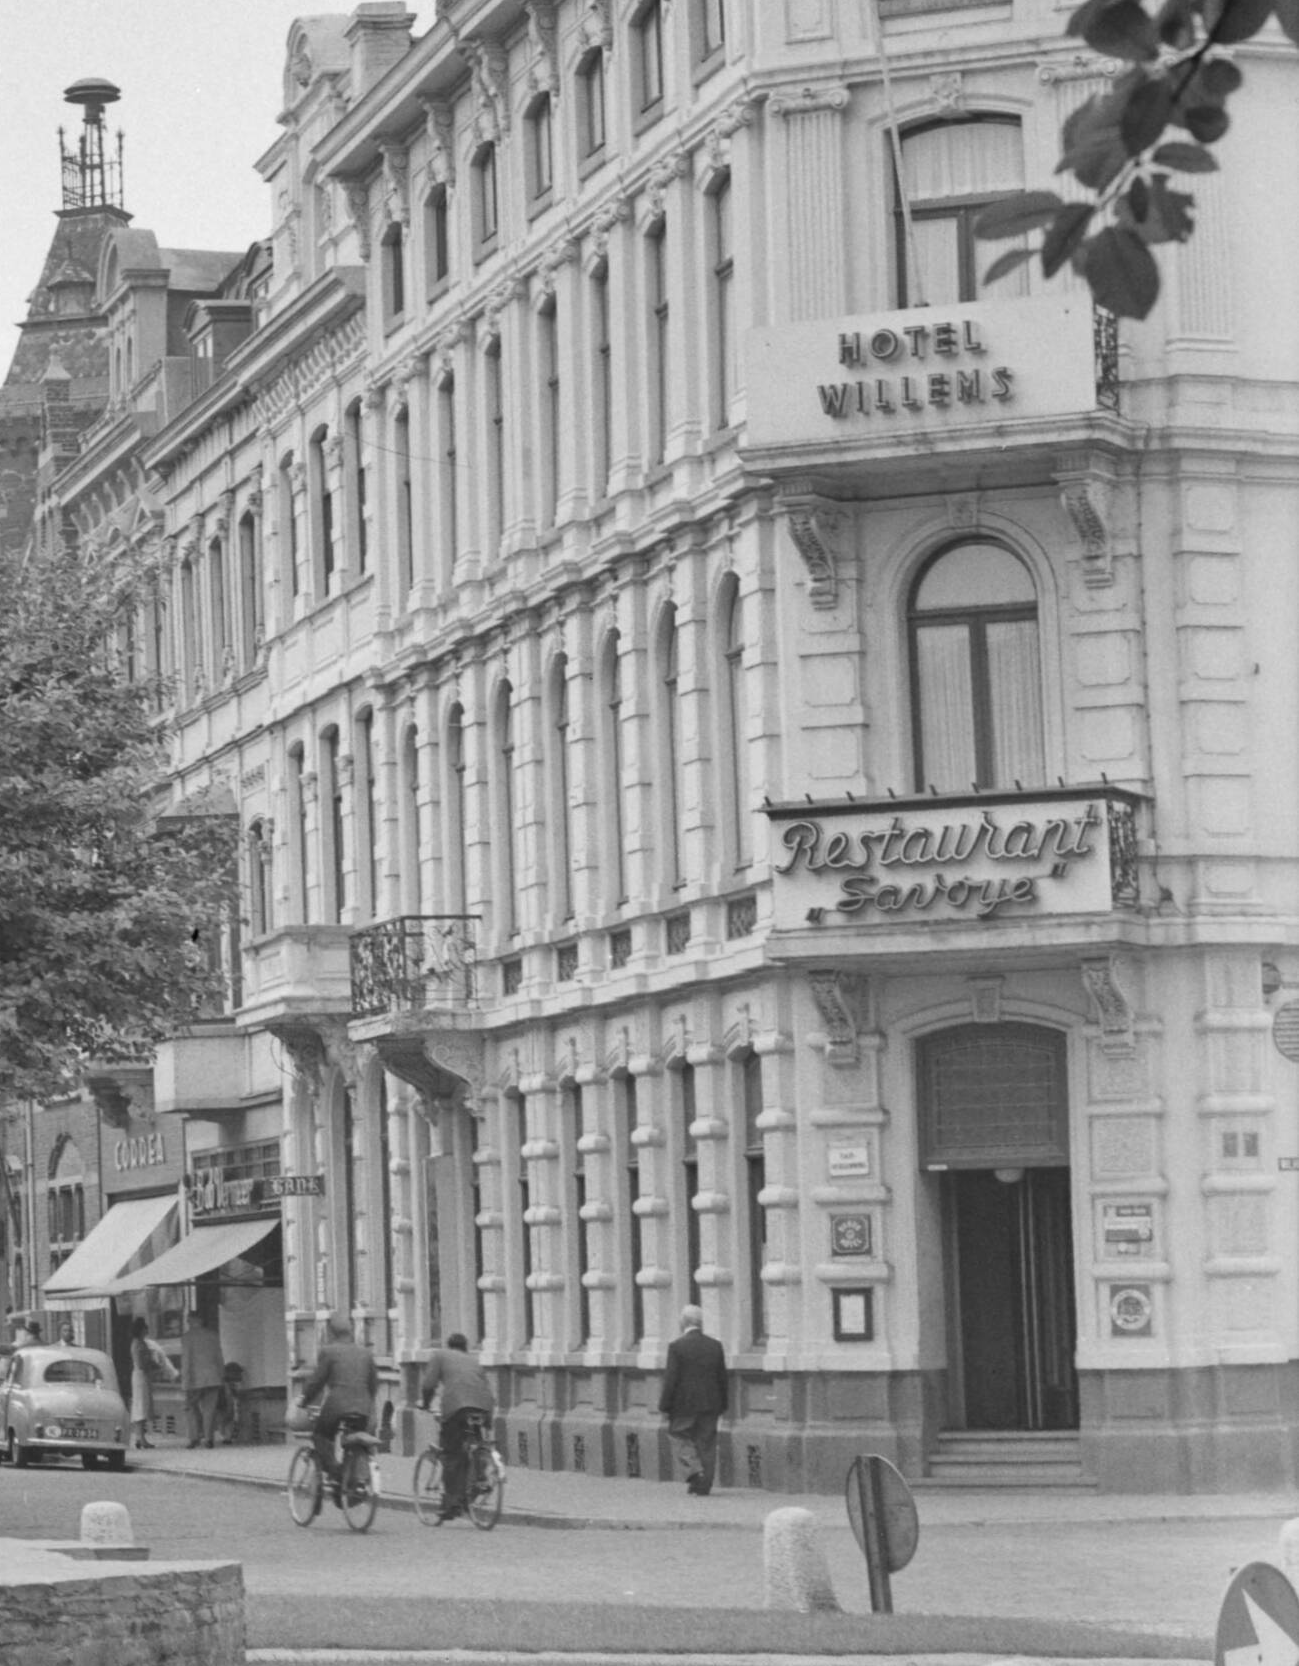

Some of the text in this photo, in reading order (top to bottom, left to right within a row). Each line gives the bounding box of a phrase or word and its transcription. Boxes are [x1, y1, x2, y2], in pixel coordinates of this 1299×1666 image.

[838, 319, 987, 367] HOTEL
[816, 366, 1014, 417] WILLEMS
[774, 803, 1104, 874] Restaurant
